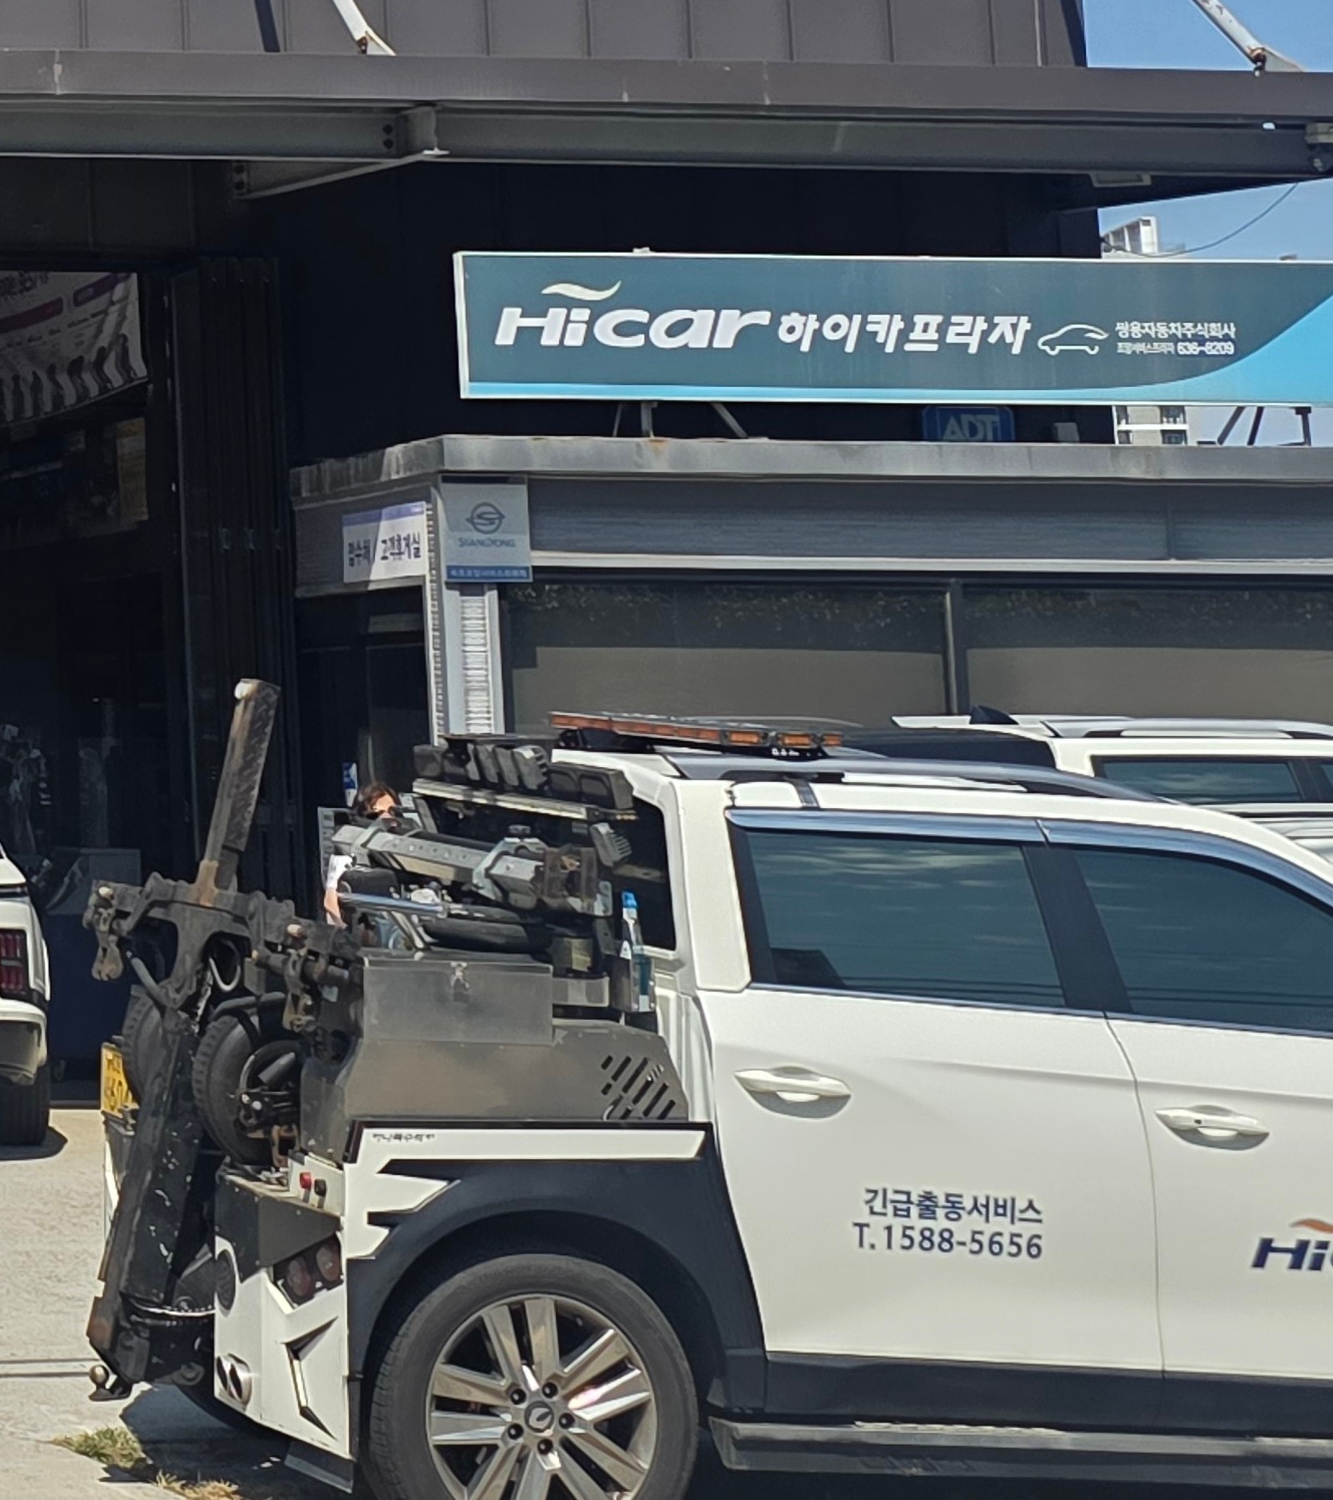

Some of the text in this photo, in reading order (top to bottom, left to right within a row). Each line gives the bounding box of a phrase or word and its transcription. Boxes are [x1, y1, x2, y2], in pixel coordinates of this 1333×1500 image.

[493, 306, 1032, 355] Hicar 하이카프라자
[1115, 321, 1237, 339] 쌍용자동차주식회사
[942, 413, 1001, 441] ADT
[863, 1187, 1043, 1225] 긴급출동서비스
[852, 1221, 1043, 1260] T.1588-5656
[1251, 1236, 1333, 1272] Hi
